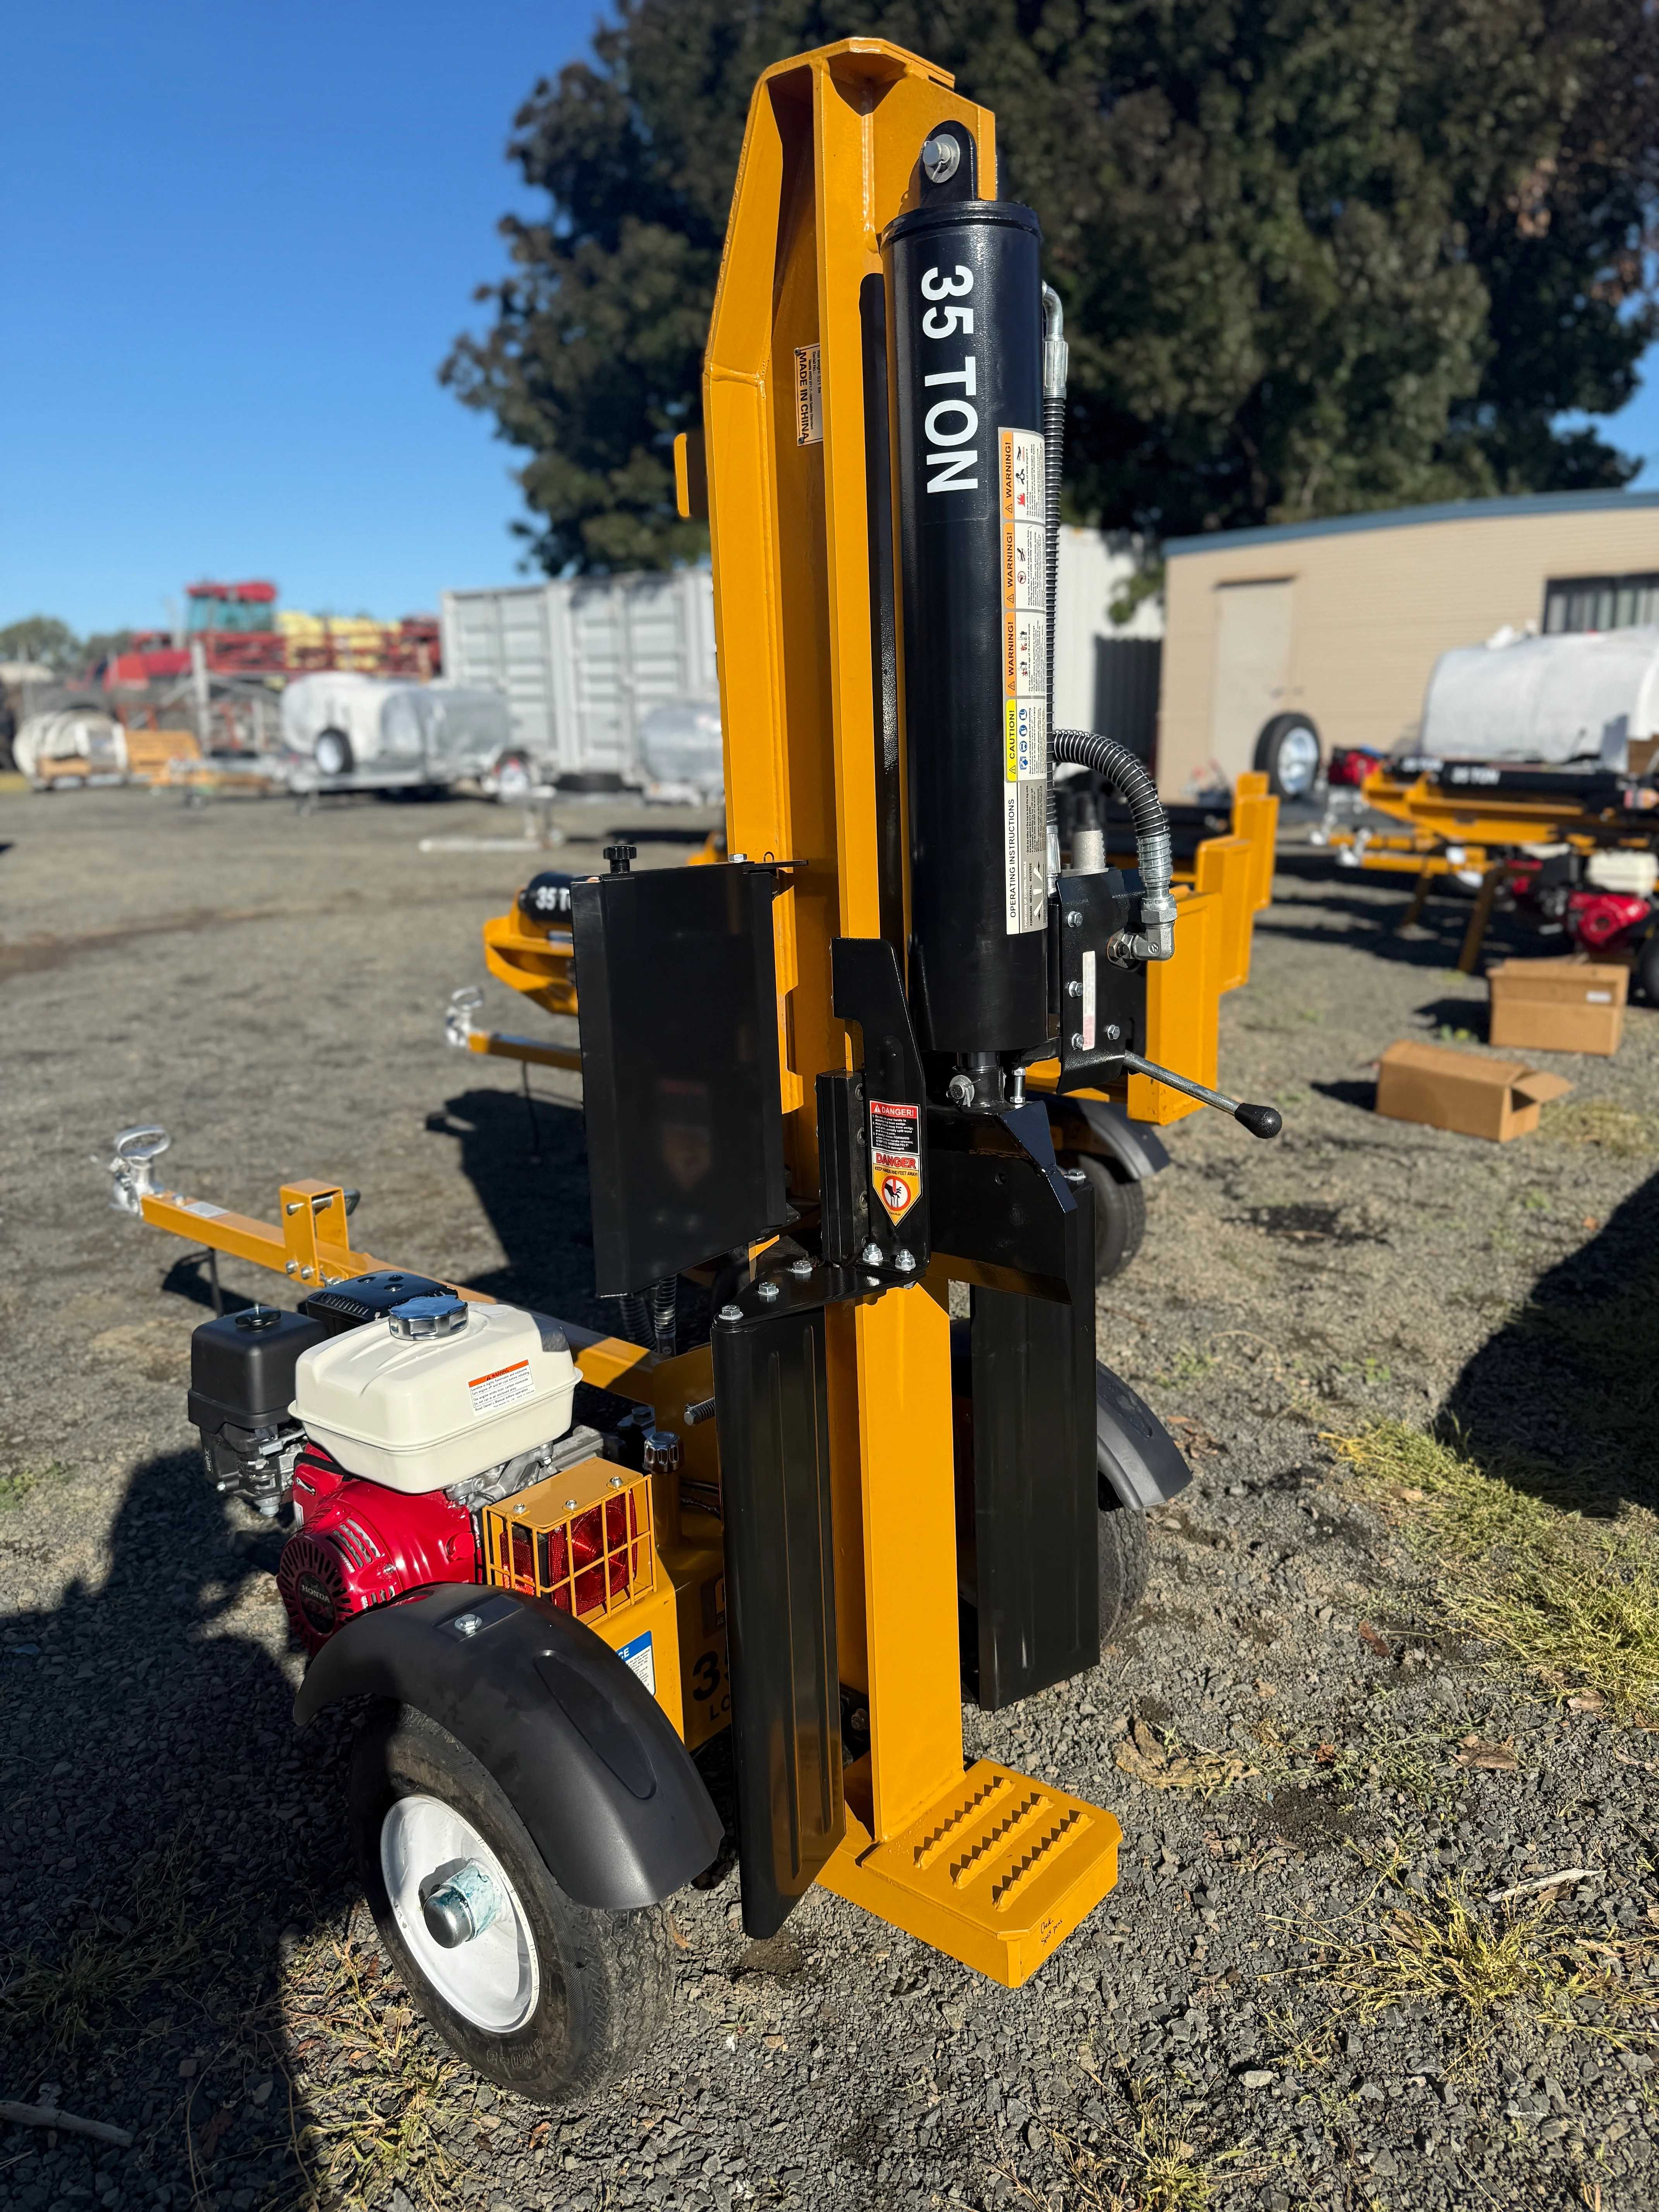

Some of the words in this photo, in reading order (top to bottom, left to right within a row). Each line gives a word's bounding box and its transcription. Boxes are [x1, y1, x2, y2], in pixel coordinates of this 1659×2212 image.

[921, 265, 974, 339] 35
[799, 352, 807, 386] MADE
[800, 389, 808, 401] IN
[801, 404, 809, 439] CHINA
[924, 356, 978, 493] TON
[536, 886, 557, 911] 35
[558, 888, 571, 912] T
[882, 1106, 914, 1116] DANGER!
[876, 1153, 916, 1169] DANGER
[492, 1368, 509, 1378] WARNING
[301, 1584, 331, 1604] HONDA
